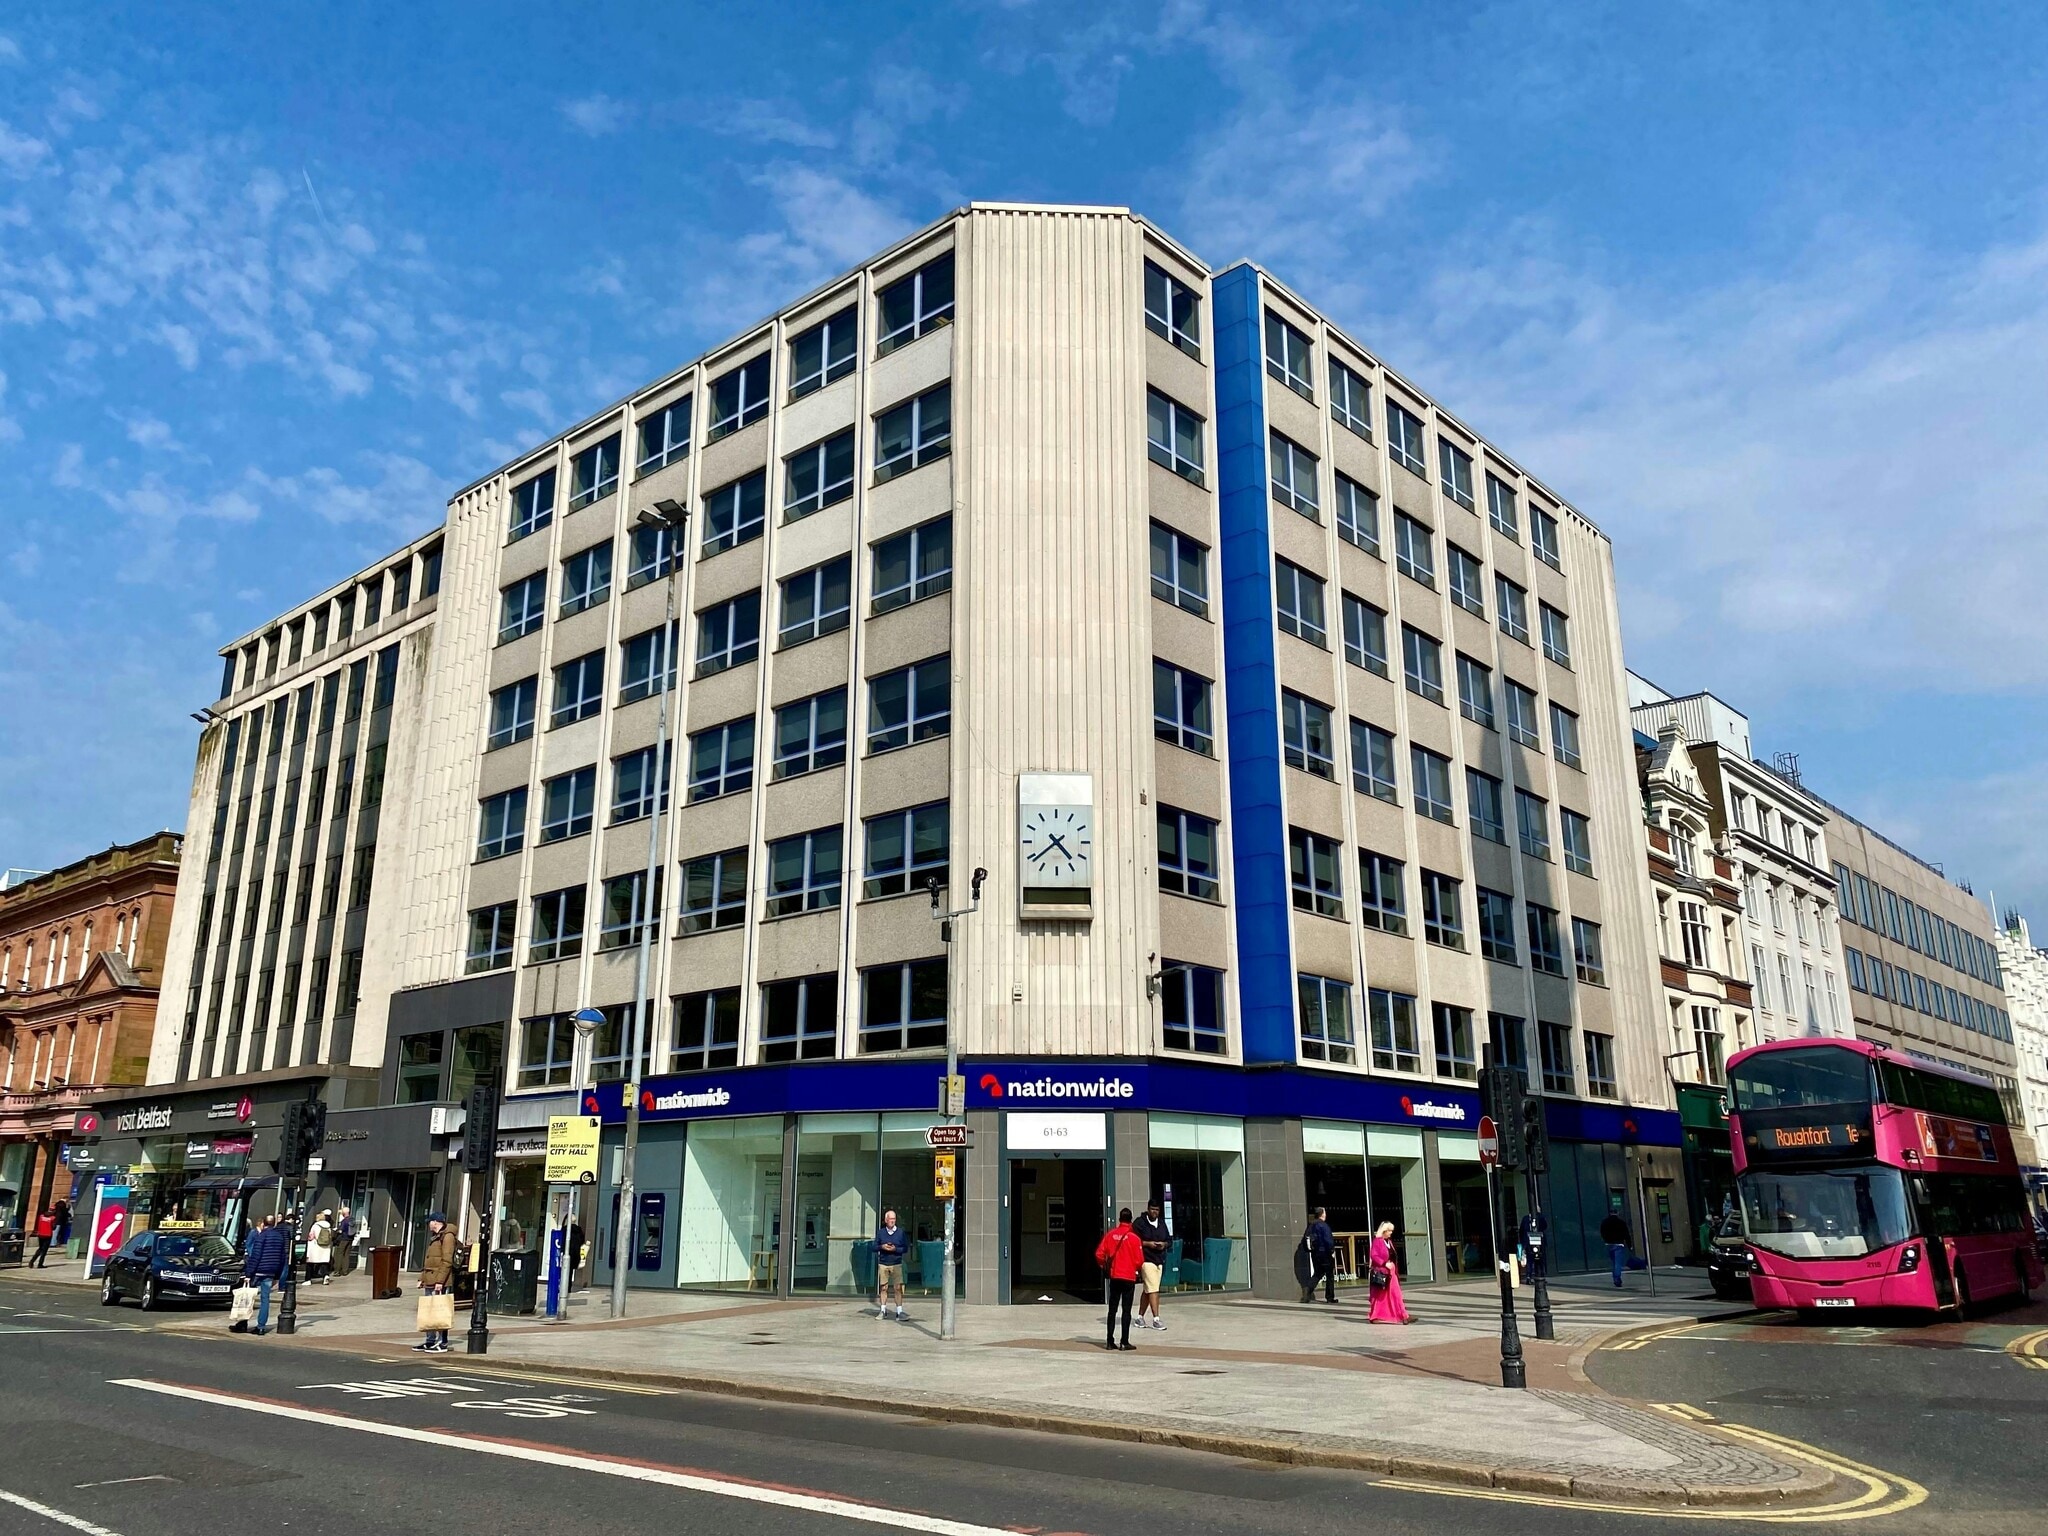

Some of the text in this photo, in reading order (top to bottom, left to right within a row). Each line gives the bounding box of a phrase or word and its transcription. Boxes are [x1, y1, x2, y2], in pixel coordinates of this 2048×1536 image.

[1008, 1077, 1133, 1098] nationwide
[656, 1088, 730, 1110] nationwide
[117, 1106, 172, 1132] visit Belfast
[1413, 1101, 1465, 1120] nationwide
[1043, 1127, 1068, 1138] 61-63
[1775, 1124, 1859, 1147] Roughfort 1e
[295, 1376, 536, 1400] LANE
